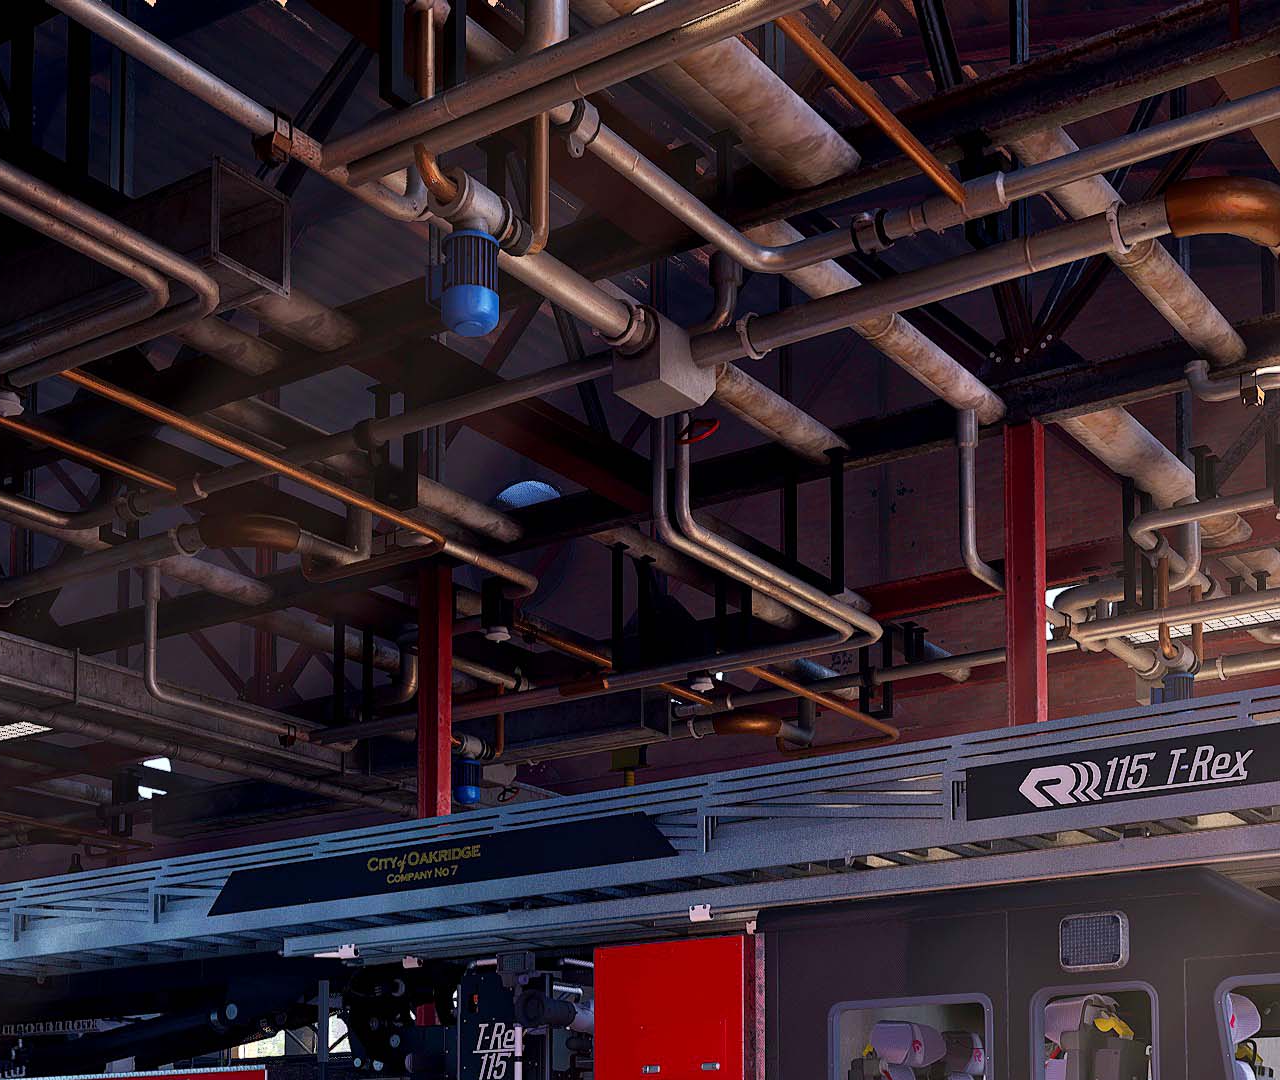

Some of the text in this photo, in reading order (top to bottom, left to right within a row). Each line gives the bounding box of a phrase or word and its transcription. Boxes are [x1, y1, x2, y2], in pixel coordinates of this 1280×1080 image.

[1166, 745, 1255, 785] T-Rex
[366, 856, 397, 872] CITY
[408, 845, 480, 866] OAKRIDGE
[386, 869, 433, 884] COMPANY
[450, 864, 459, 876] 7
